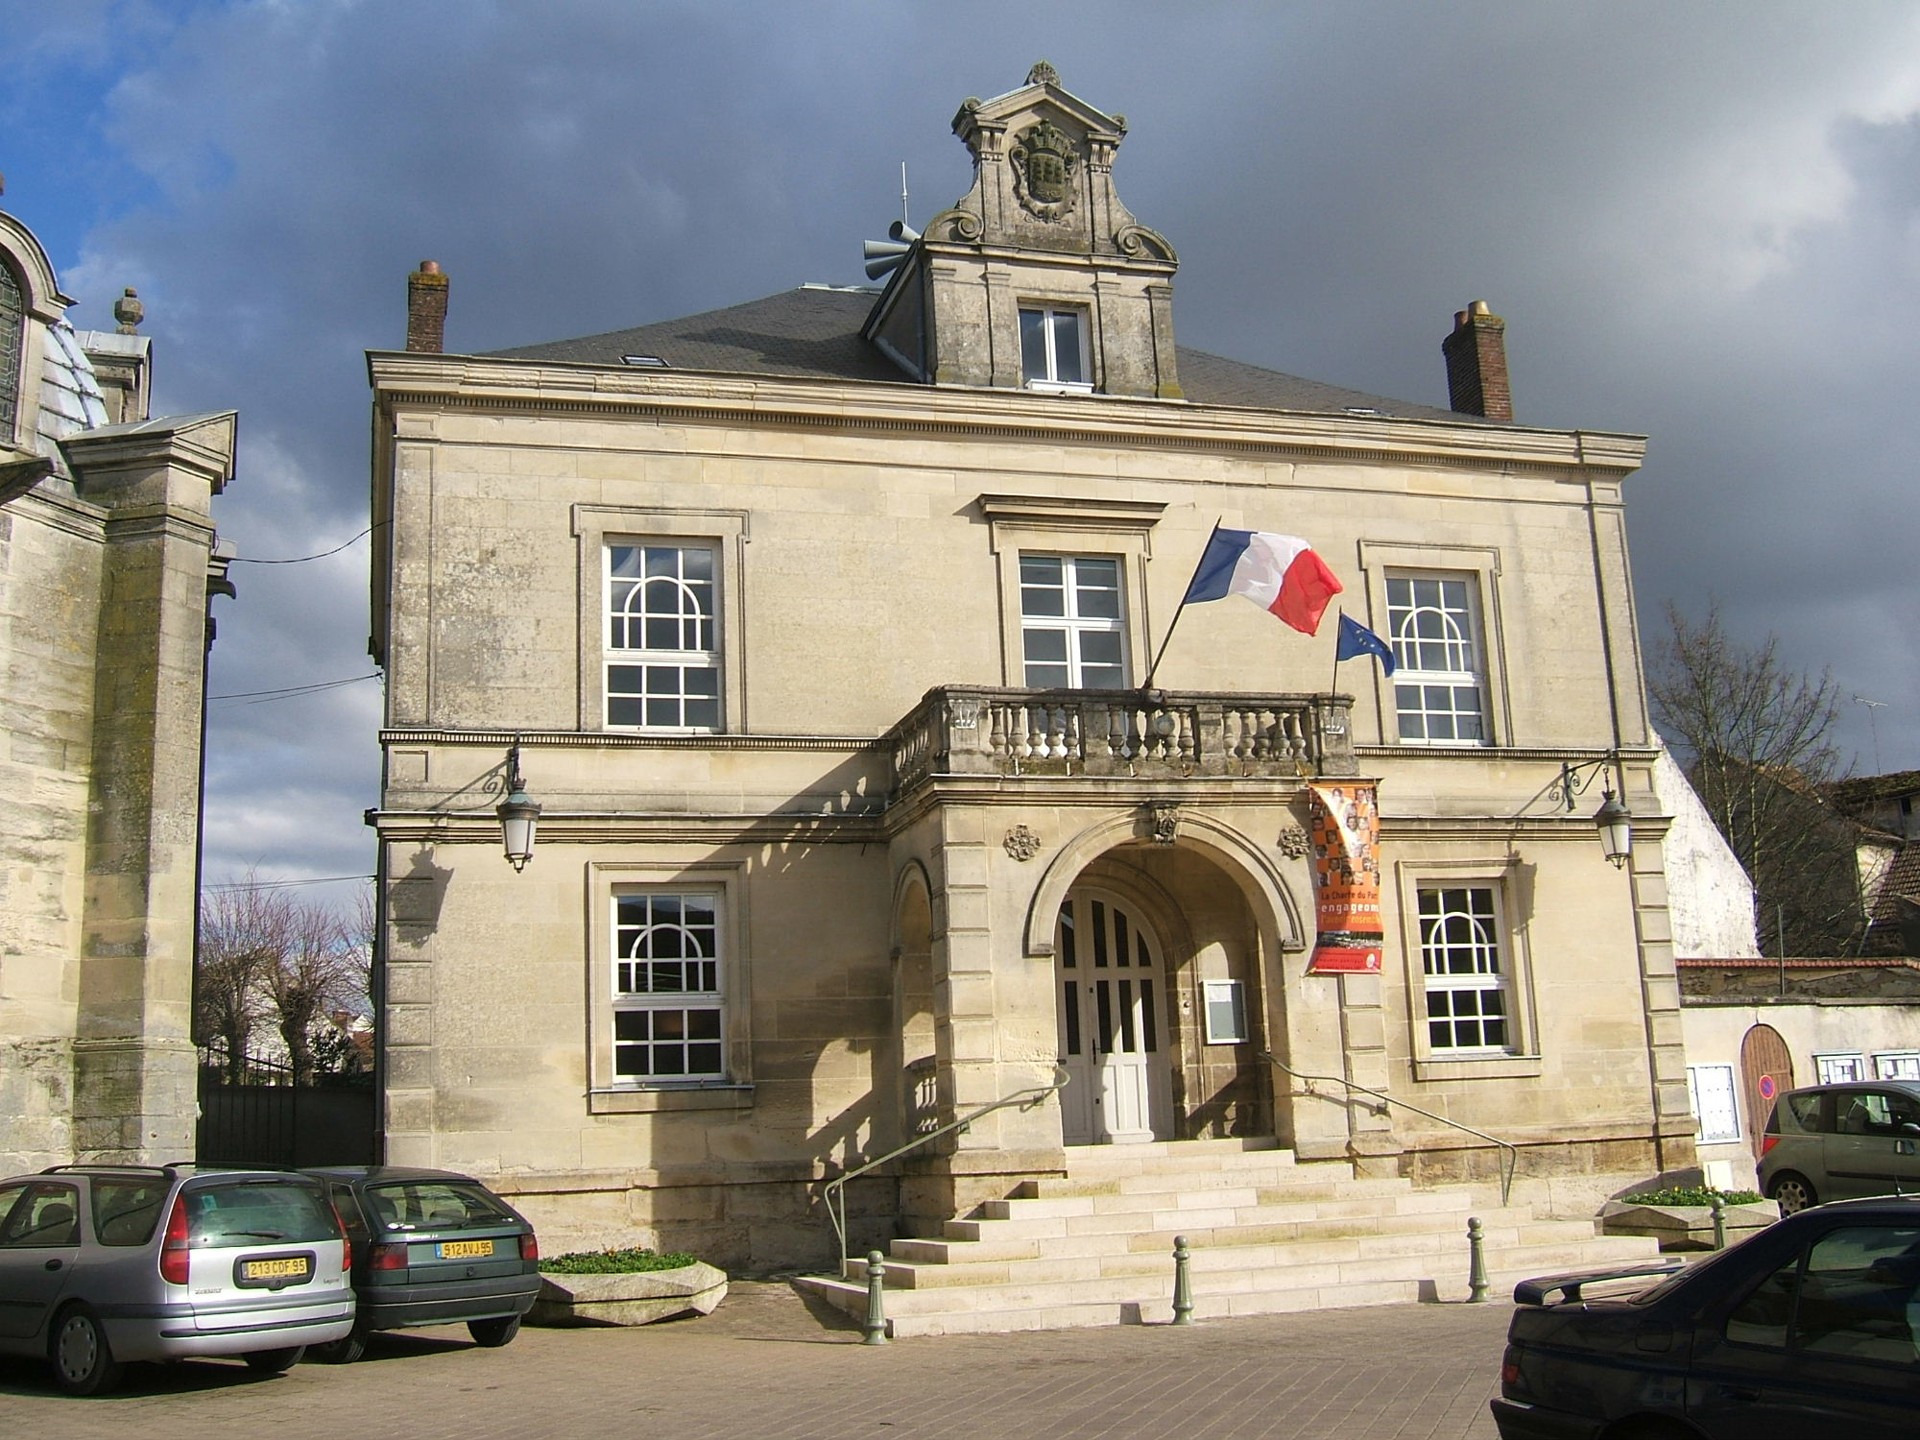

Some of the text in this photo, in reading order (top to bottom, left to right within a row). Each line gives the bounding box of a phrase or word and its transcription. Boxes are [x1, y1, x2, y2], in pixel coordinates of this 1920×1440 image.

[1321, 891, 1378, 900] La Charte du Par
[250, 1259, 305, 1276] 213 CDF 95
